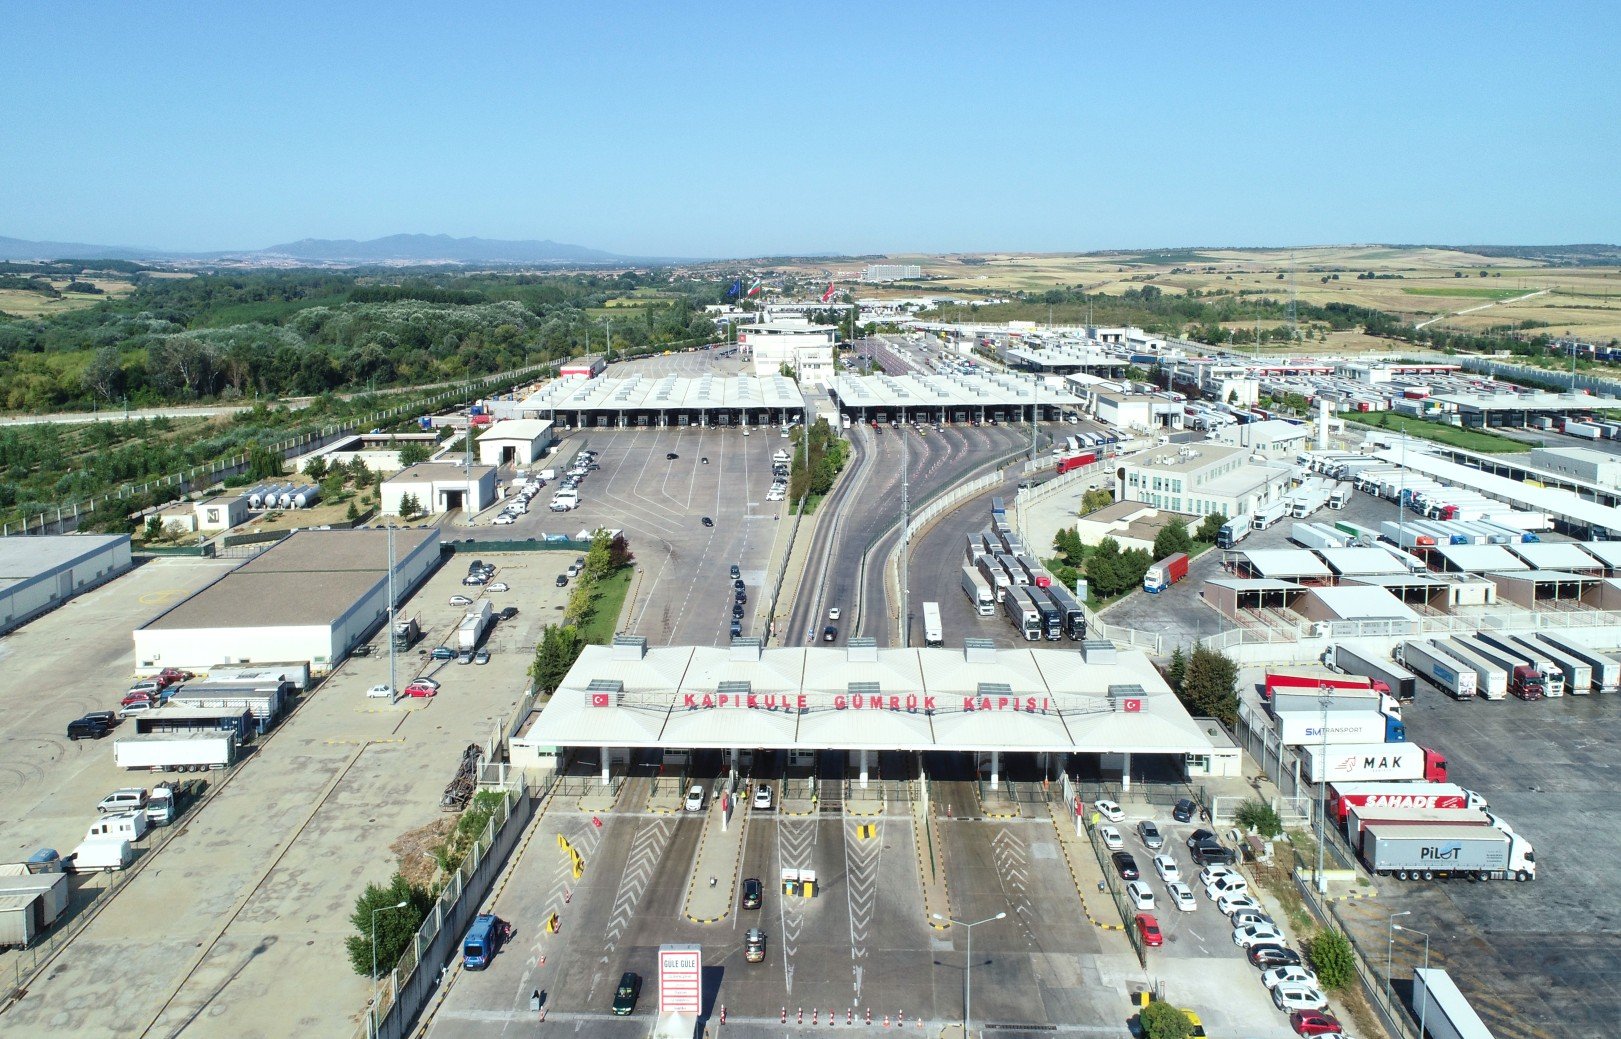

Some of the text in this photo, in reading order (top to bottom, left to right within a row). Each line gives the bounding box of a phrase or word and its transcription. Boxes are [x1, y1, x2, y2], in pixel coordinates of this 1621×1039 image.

[684, 693, 1049, 711] KAPIKULE GÜMRÜK KAPISI
[1364, 756, 1402, 769] MAK
[1365, 795, 1439, 808] SAHADE
